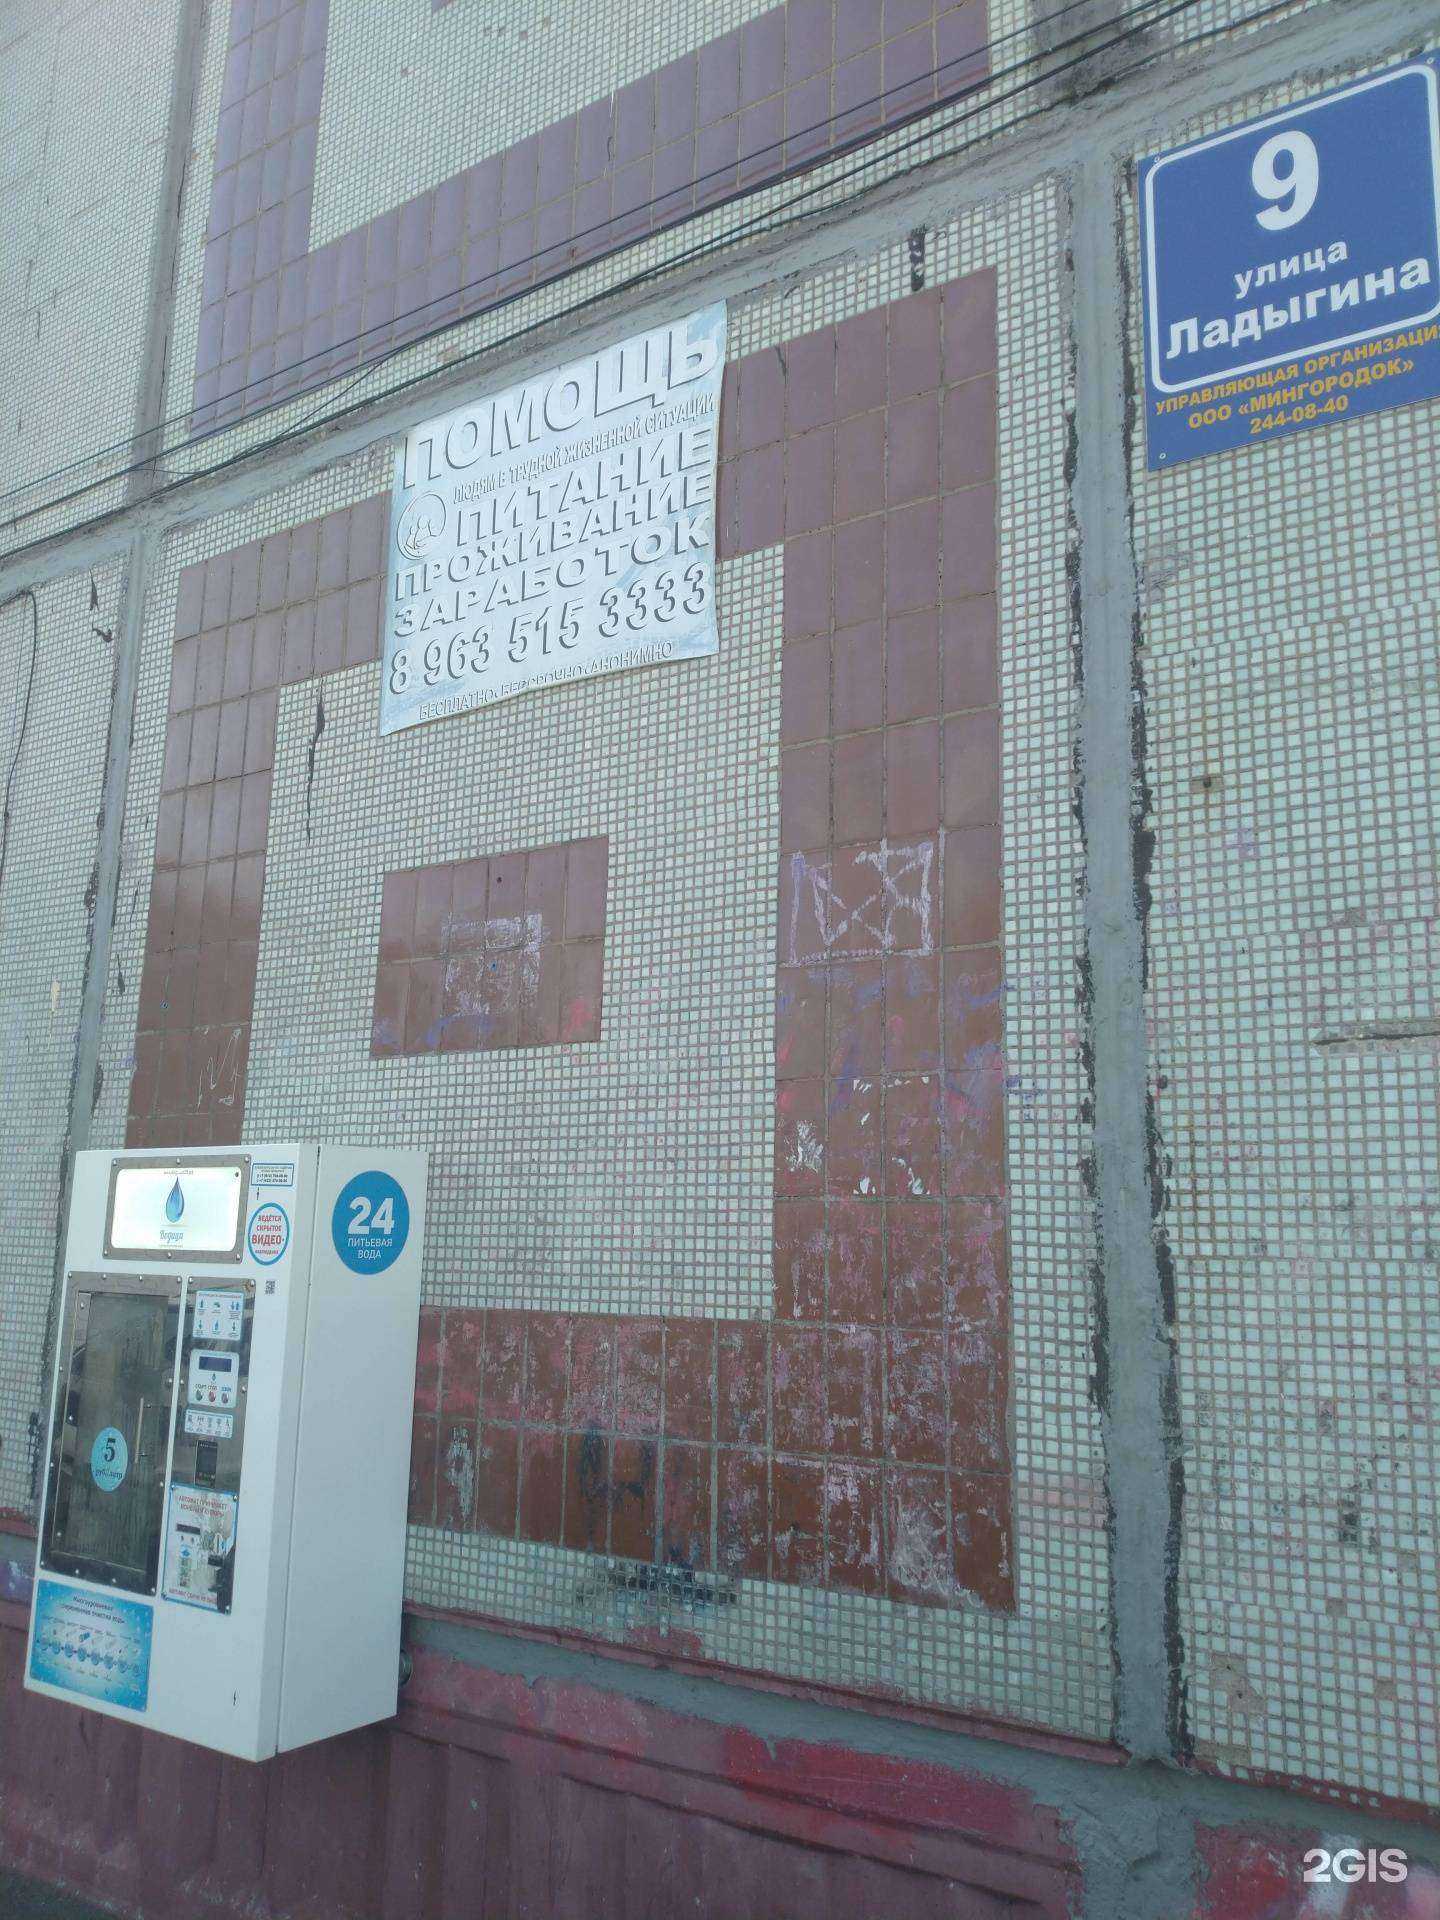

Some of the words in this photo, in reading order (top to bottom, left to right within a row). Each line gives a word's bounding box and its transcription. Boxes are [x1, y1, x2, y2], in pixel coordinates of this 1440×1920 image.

[1251, 130, 1320, 231] 9
[1165, 257, 1431, 359] Ладыгина
[1233, 240, 1349, 300] улица
[402, 318, 717, 489] ПОМОЩЬ
[1156, 364, 1299, 416] УПРАВЛЯЮЩАЯ
[1304, 324, 1440, 374] ОРГАНИЗАЦИ
[1188, 405, 1231, 430] ООО
[1238, 359, 1414, 415] «МИНГОРОДОК»
[1250, 395, 1349, 434] 244-08-40
[453, 473, 496, 505] ЛЮДЯМ
[508, 446, 563, 483] ТРУДНОЙ
[563, 416, 642, 465] ЖИЗНЕННОЙ
[645, 392, 716, 435] СИТУАЦИИ
[456, 426, 712, 547] ПИТАНИЕ
[394, 514, 711, 638] ЗАРАБОТОК
[395, 472, 712, 602] ПРОЖИВАНИЕ
[389, 646, 409, 695] 8
[423, 622, 493, 686] 963
[507, 596, 585, 663] 515
[598, 559, 708, 638] 3333
[347, 1196, 395, 1235] 24
[347, 1238, 393, 1248] ПИТЬЕВАЯ
[358, 1249, 381, 1260] ВОДА
[104, 1437, 116, 1463] 5
